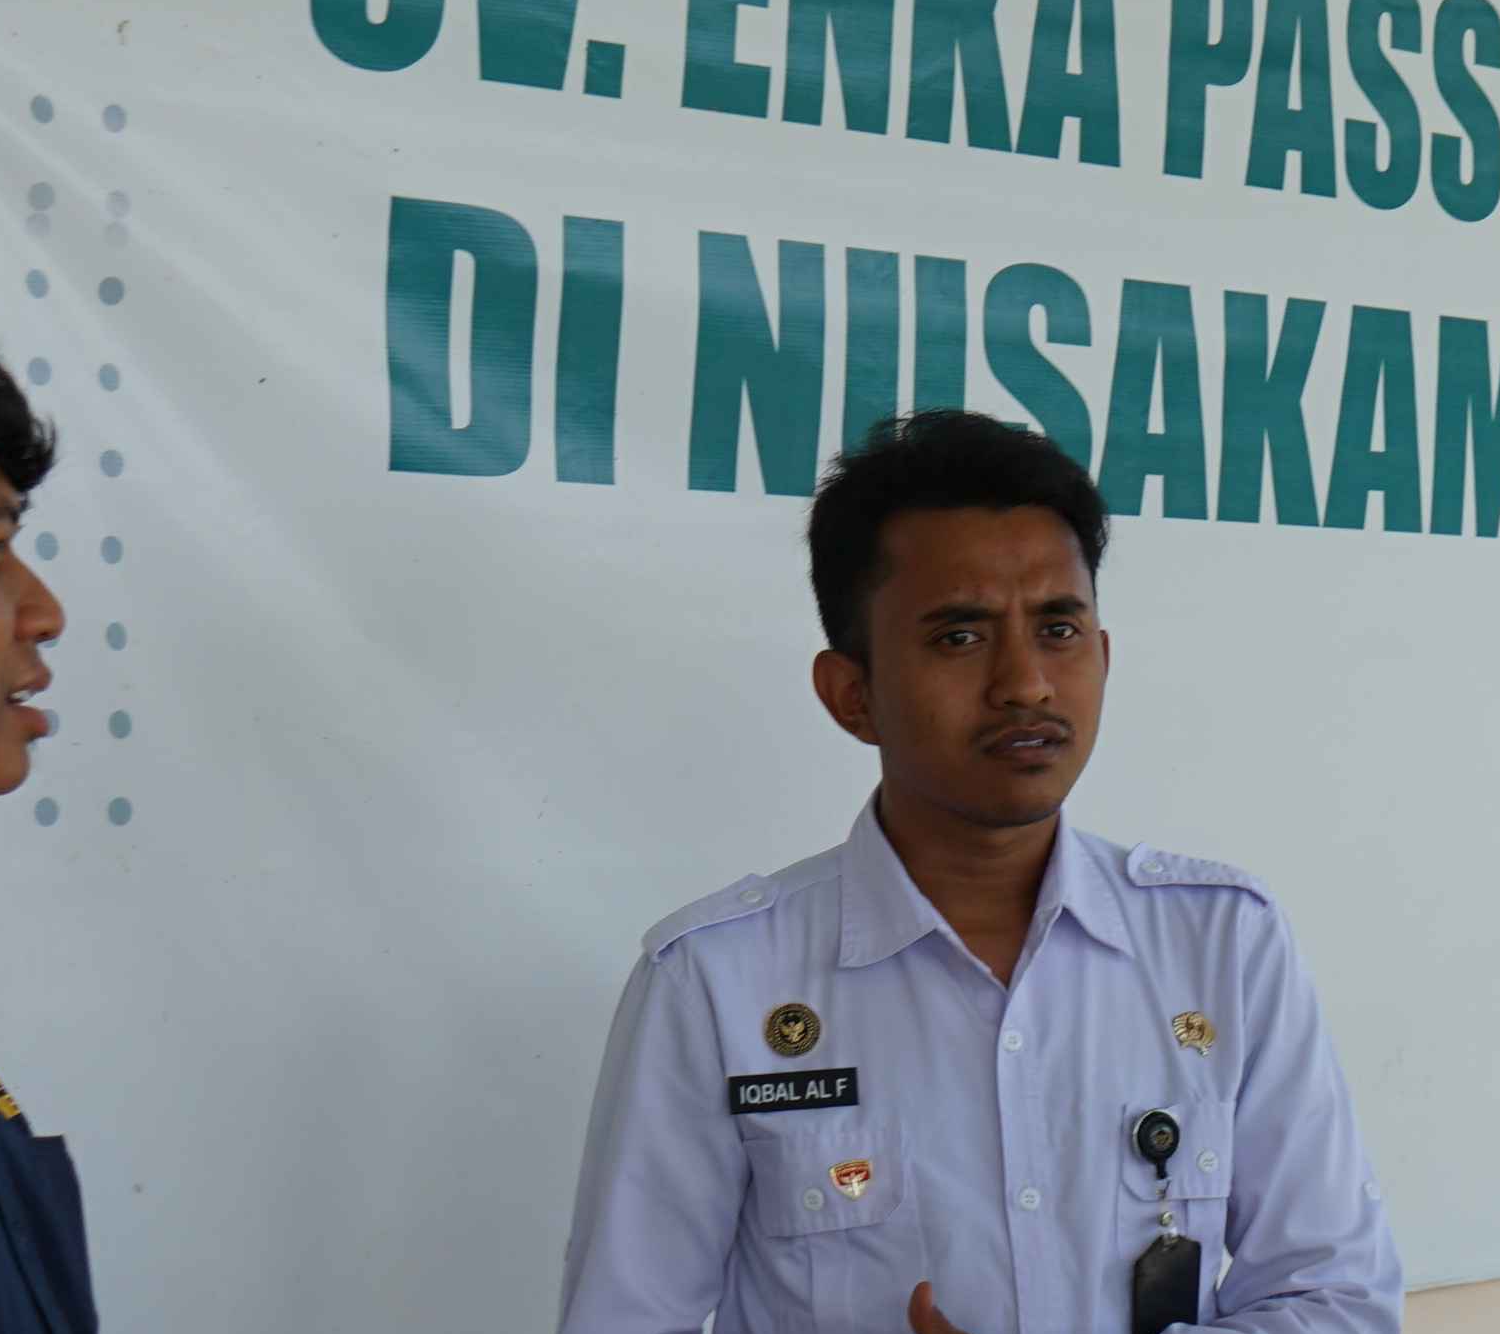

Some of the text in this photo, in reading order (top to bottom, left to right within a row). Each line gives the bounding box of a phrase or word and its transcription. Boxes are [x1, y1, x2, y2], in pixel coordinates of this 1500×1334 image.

[386, 197, 625, 485] DI
[739, 1077, 848, 1105] IQBAL AL F
